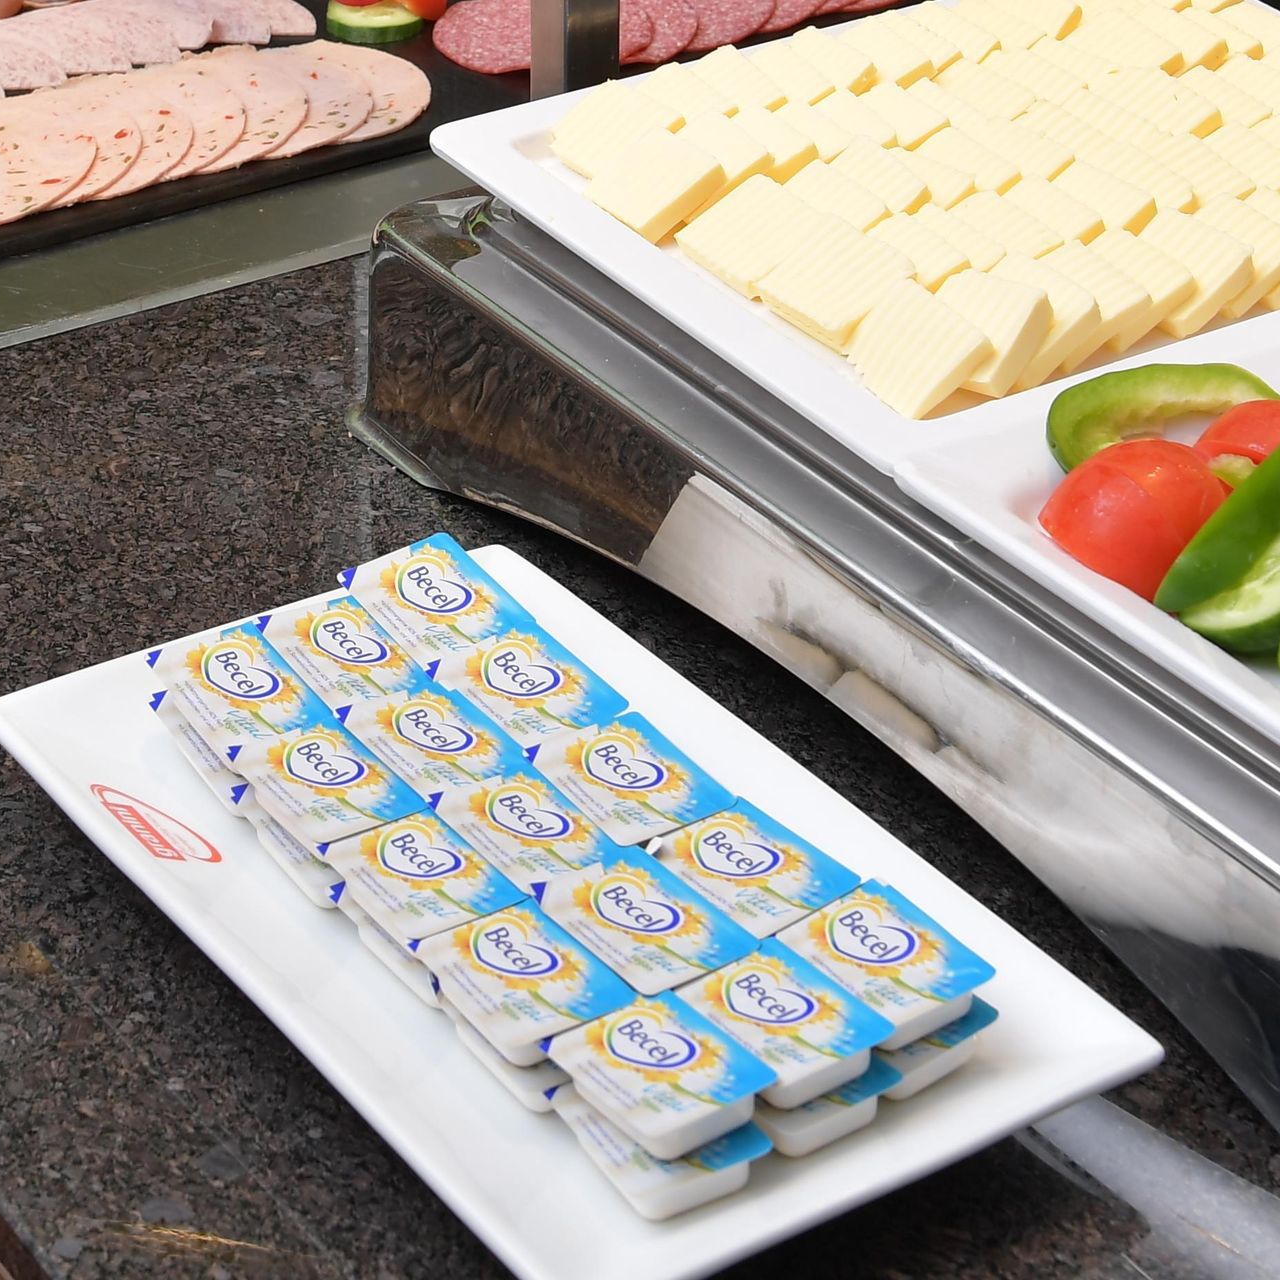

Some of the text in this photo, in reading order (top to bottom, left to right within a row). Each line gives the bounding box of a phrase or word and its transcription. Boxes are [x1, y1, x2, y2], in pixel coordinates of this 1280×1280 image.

[407, 565, 458, 609] Becel
[322, 620, 375, 661] Becel
[425, 625, 471, 652] Vital
[214, 650, 266, 694] Becel
[493, 650, 547, 693] Becel
[405, 708, 459, 750] Becel
[296, 741, 350, 782] Becel
[594, 744, 650, 786] Becel
[498, 794, 555, 835] Becel
[390, 832, 446, 874] Becel
[702, 830, 766, 873] Becel
[602, 885, 666, 929] Becel
[483, 926, 543, 970] Becel
[838, 909, 900, 959] Becel
[735, 973, 799, 1020] Becel
[617, 1019, 680, 1063] Becel
